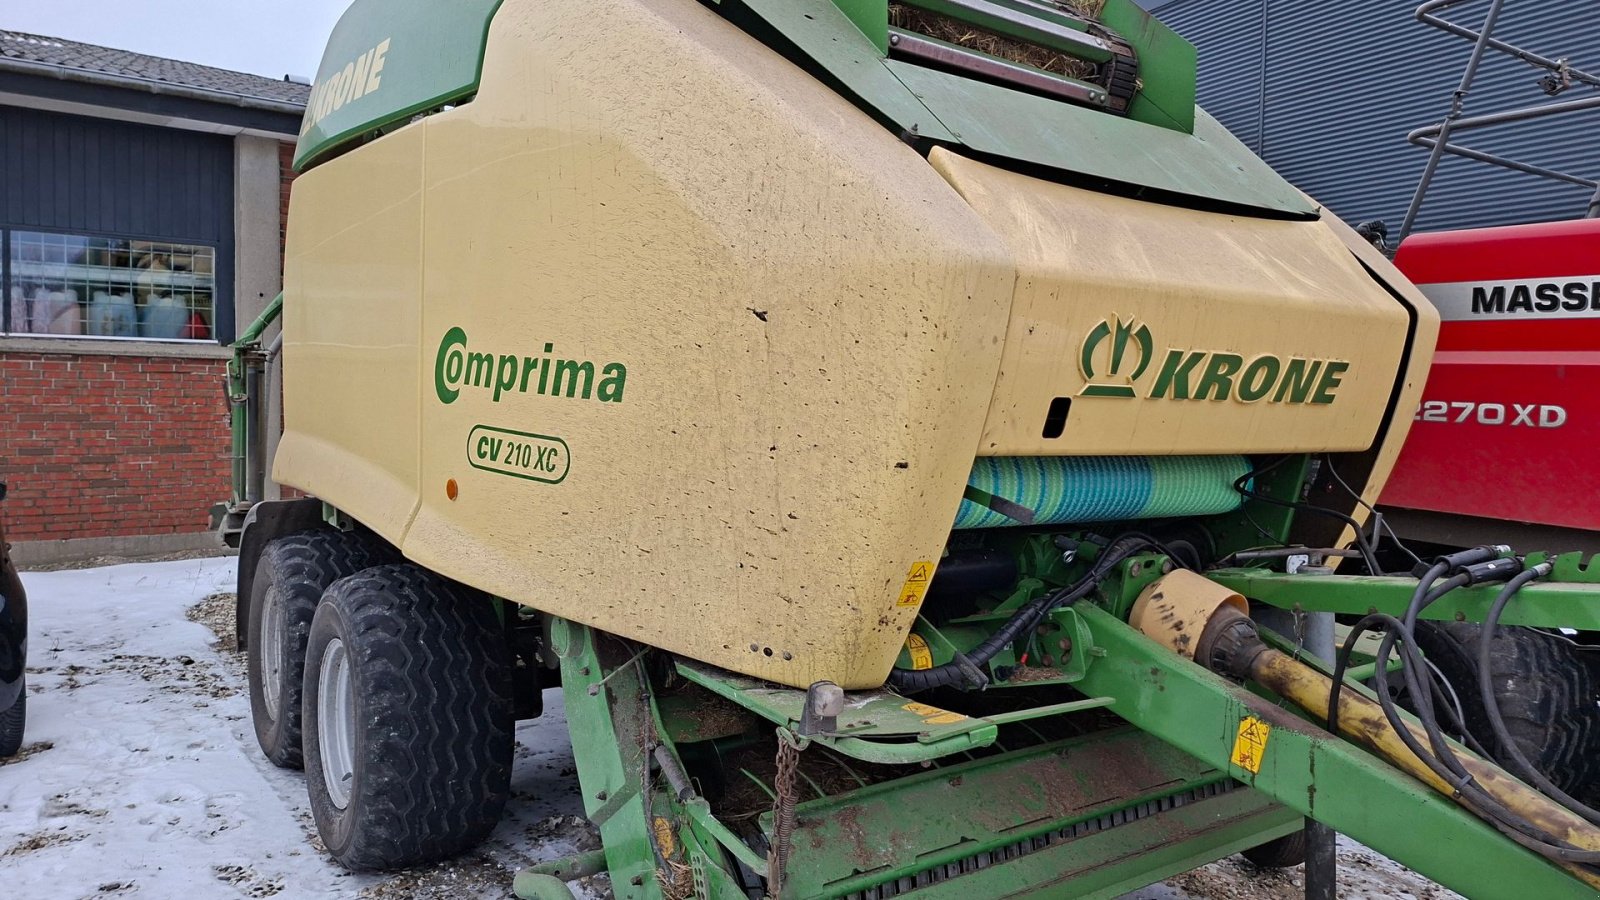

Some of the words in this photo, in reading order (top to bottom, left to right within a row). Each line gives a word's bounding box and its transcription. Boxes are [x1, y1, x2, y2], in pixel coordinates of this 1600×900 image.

[310, 37, 391, 128] KRONE
[434, 326, 627, 404] Comprima
[1146, 349, 1350, 405] KRONE
[1414, 401, 1505, 424] 270
[1510, 404, 1567, 427] XD
[477, 436, 502, 462] CV
[504, 442, 532, 468] 210
[533, 445, 558, 473] XC
